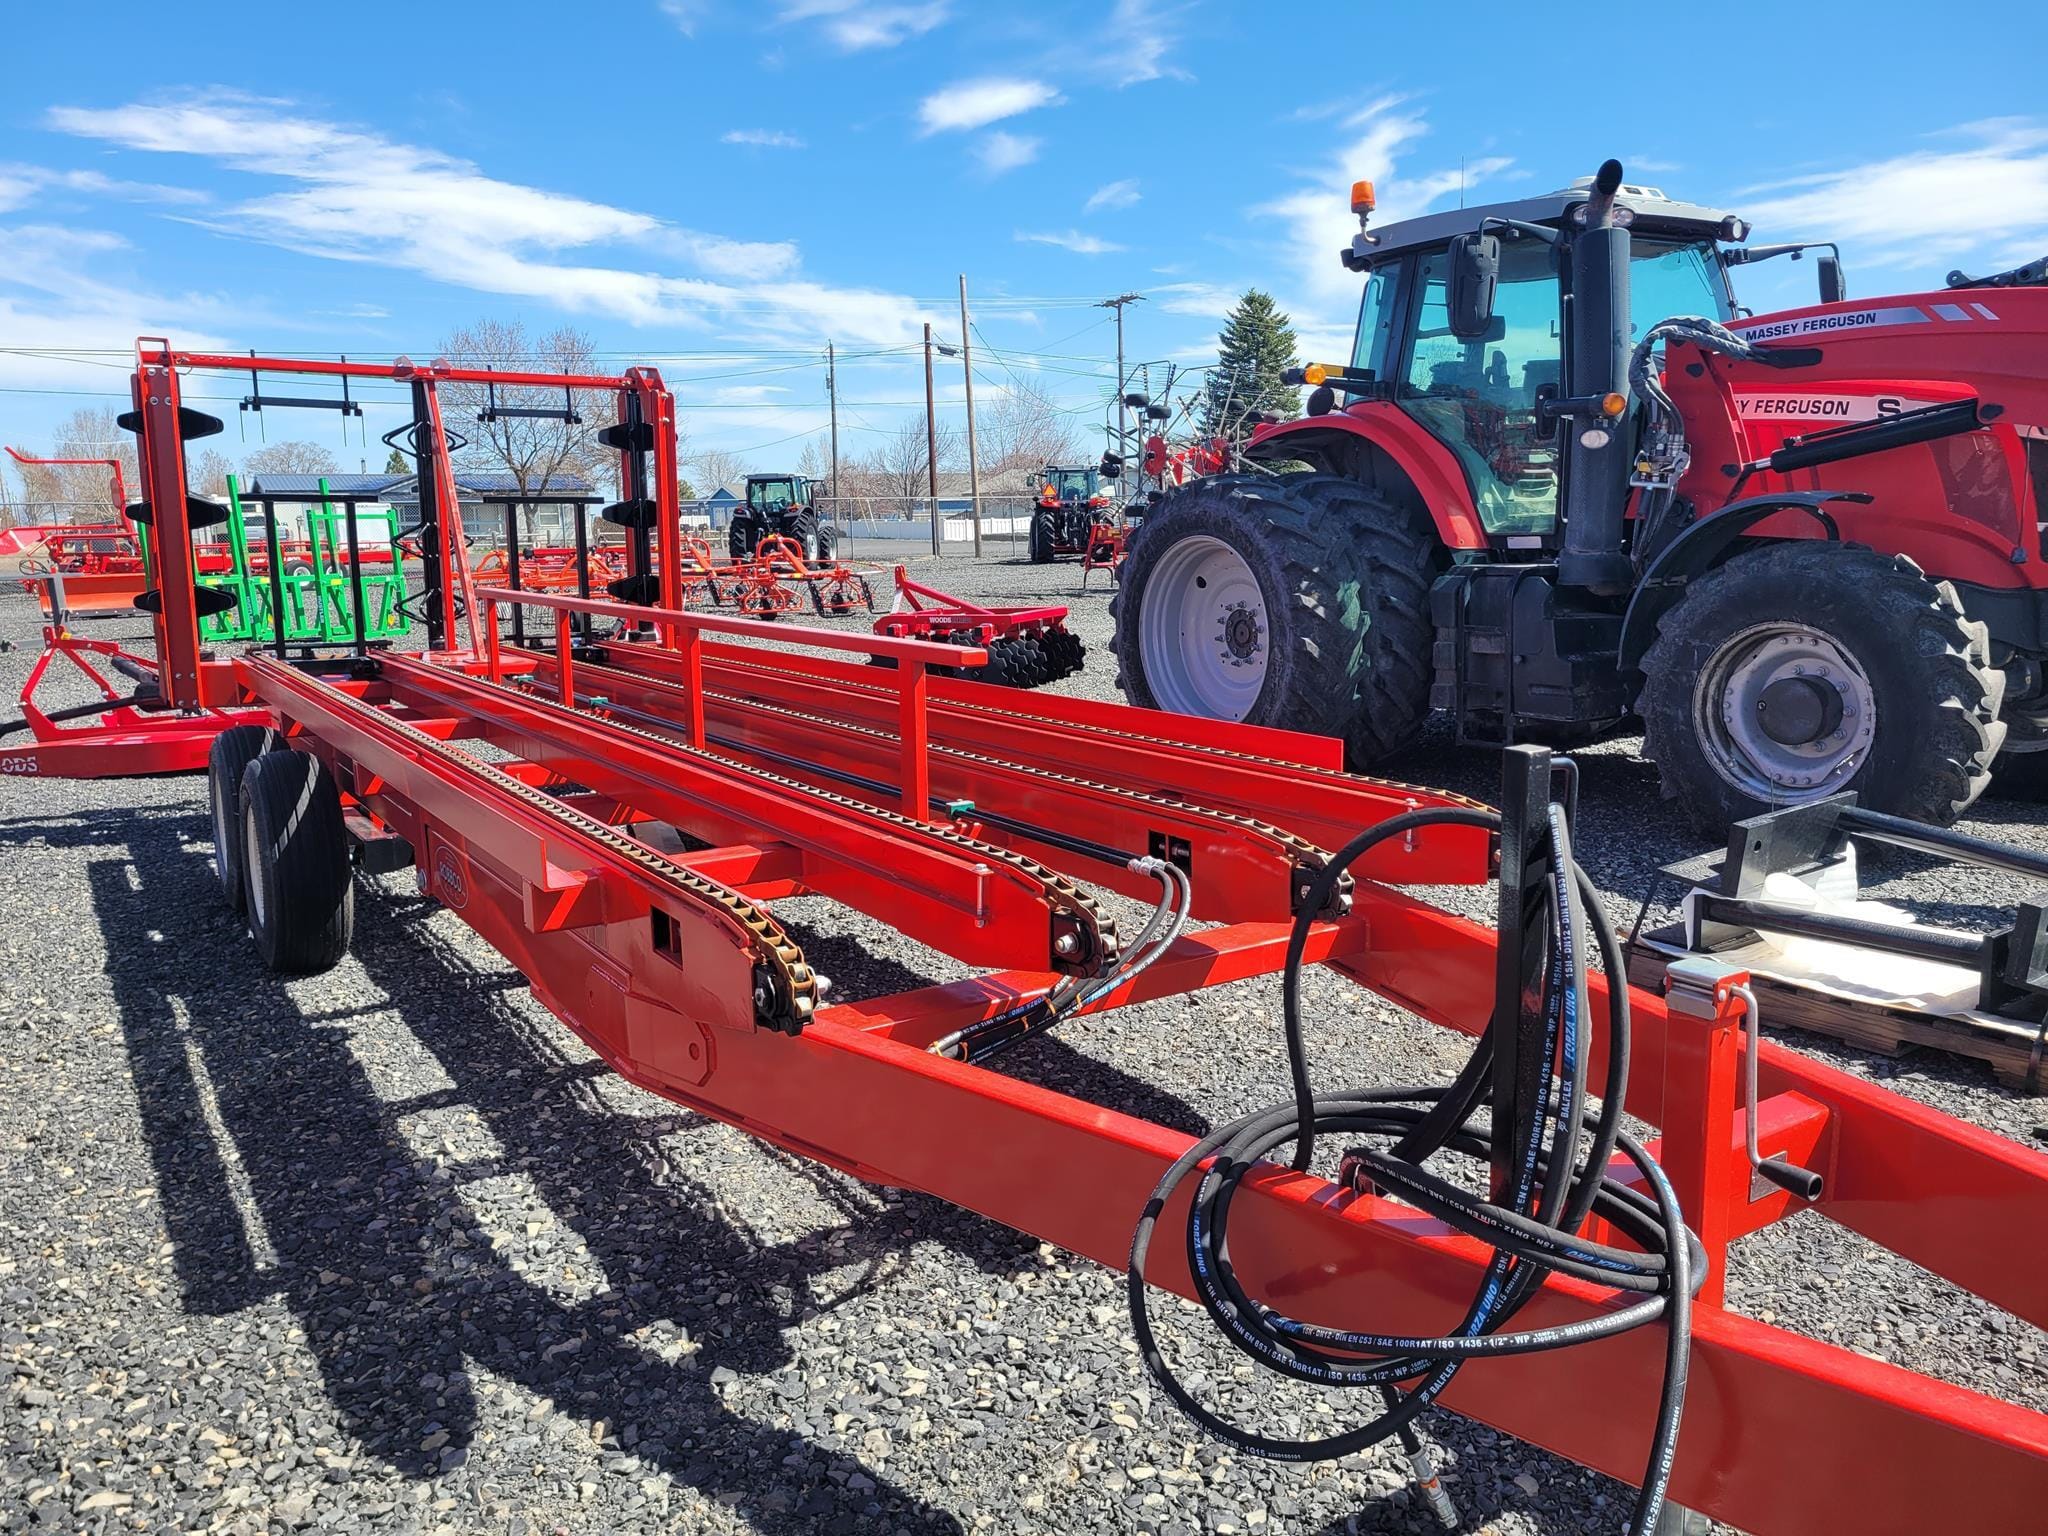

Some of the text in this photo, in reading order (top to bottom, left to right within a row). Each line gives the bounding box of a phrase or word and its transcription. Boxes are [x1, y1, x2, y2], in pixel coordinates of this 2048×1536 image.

[1745, 312, 1877, 342] MASSEY FERGUSON
[1754, 400, 1850, 416] FERGUSON
[1560, 894, 1568, 907] EN
[1562, 908, 1570, 924] DIN
[1562, 930, 1572, 954] DN12
[1564, 959, 1574, 978] 1SN
[1566, 990, 1576, 1017] UNO
[1564, 1022, 1576, 1060] FORZA
[1542, 1062, 1551, 1084] 1436
[1538, 1088, 1547, 1108] ISO
[1560, 1080, 1572, 1118] BALFLEX
[1530, 1110, 1544, 1148] 100R1AT
[1526, 1151, 1536, 1169] SAE
[1518, 1192, 1528, 1204] EN
[1504, 1226, 1530, 1240] DN12
[1536, 1238, 1555, 1250] 1SN
[1196, 1252, 1206, 1274] UNO
[1205, 1281, 1216, 1298] 1SN
[1216, 1300, 1231, 1322] DN12
[1232, 1319, 1246, 1334] DIN
[1244, 1332, 1255, 1344] EN
[1272, 1350, 1287, 1364] SAE
[1288, 1358, 1323, 1378] 100R1AT
[1328, 1370, 1342, 1380] ISO
[1346, 1371, 1367, 1382] 1436
[1394, 1366, 1408, 1377] WP
[1430, 1256, 1509, 1394] BALFLEX ORZA UNO 1SN
[1335, 1332, 1348, 1342] DIN
[1348, 1335, 1359, 1344] EN
[1376, 1338, 1393, 1347] SAE
[1395, 1340, 1432, 1349] 100R1AT
[1438, 1340, 1454, 1349] ISO
[1459, 1338, 1482, 1348] 1436
[1514, 1334, 1530, 1345] WP
[1566, 1324, 1594, 1337] MSHA
[1245, 1445, 1266, 1457] 1Q15
[1646, 1480, 1666, 1528] IC-252/00
[1660, 1448, 1673, 1474] 1Q15
